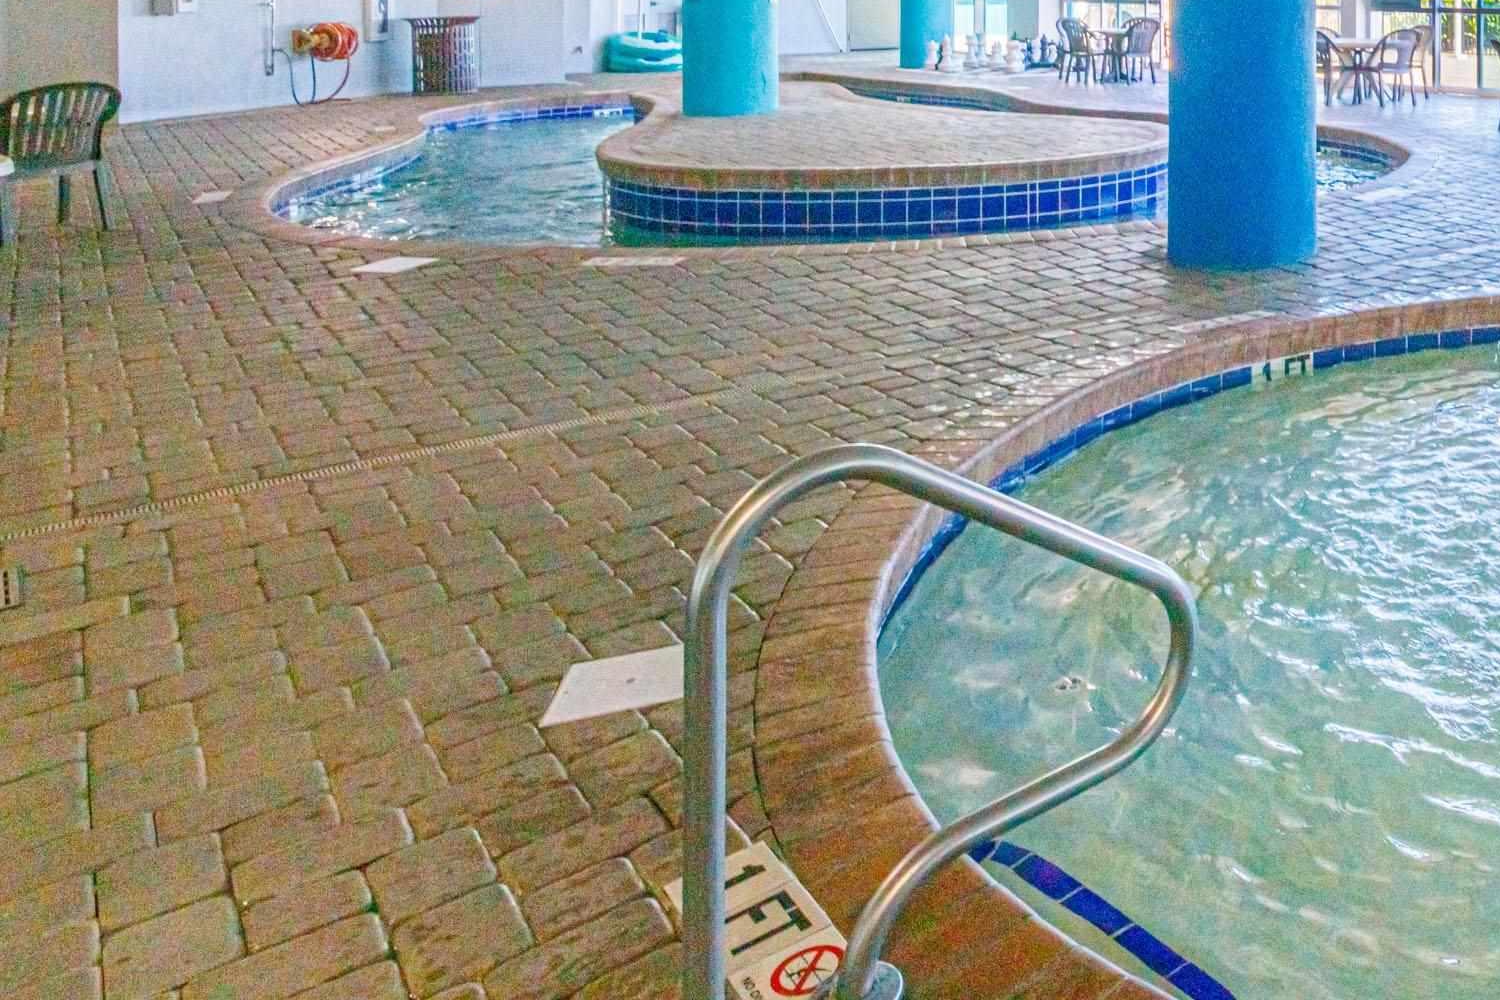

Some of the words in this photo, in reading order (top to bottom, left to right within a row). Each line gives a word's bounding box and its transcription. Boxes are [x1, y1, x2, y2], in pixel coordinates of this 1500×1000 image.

[1262, 361, 1273, 382] 1
[1284, 353, 1311, 377] FT
[725, 890, 813, 956] FT
